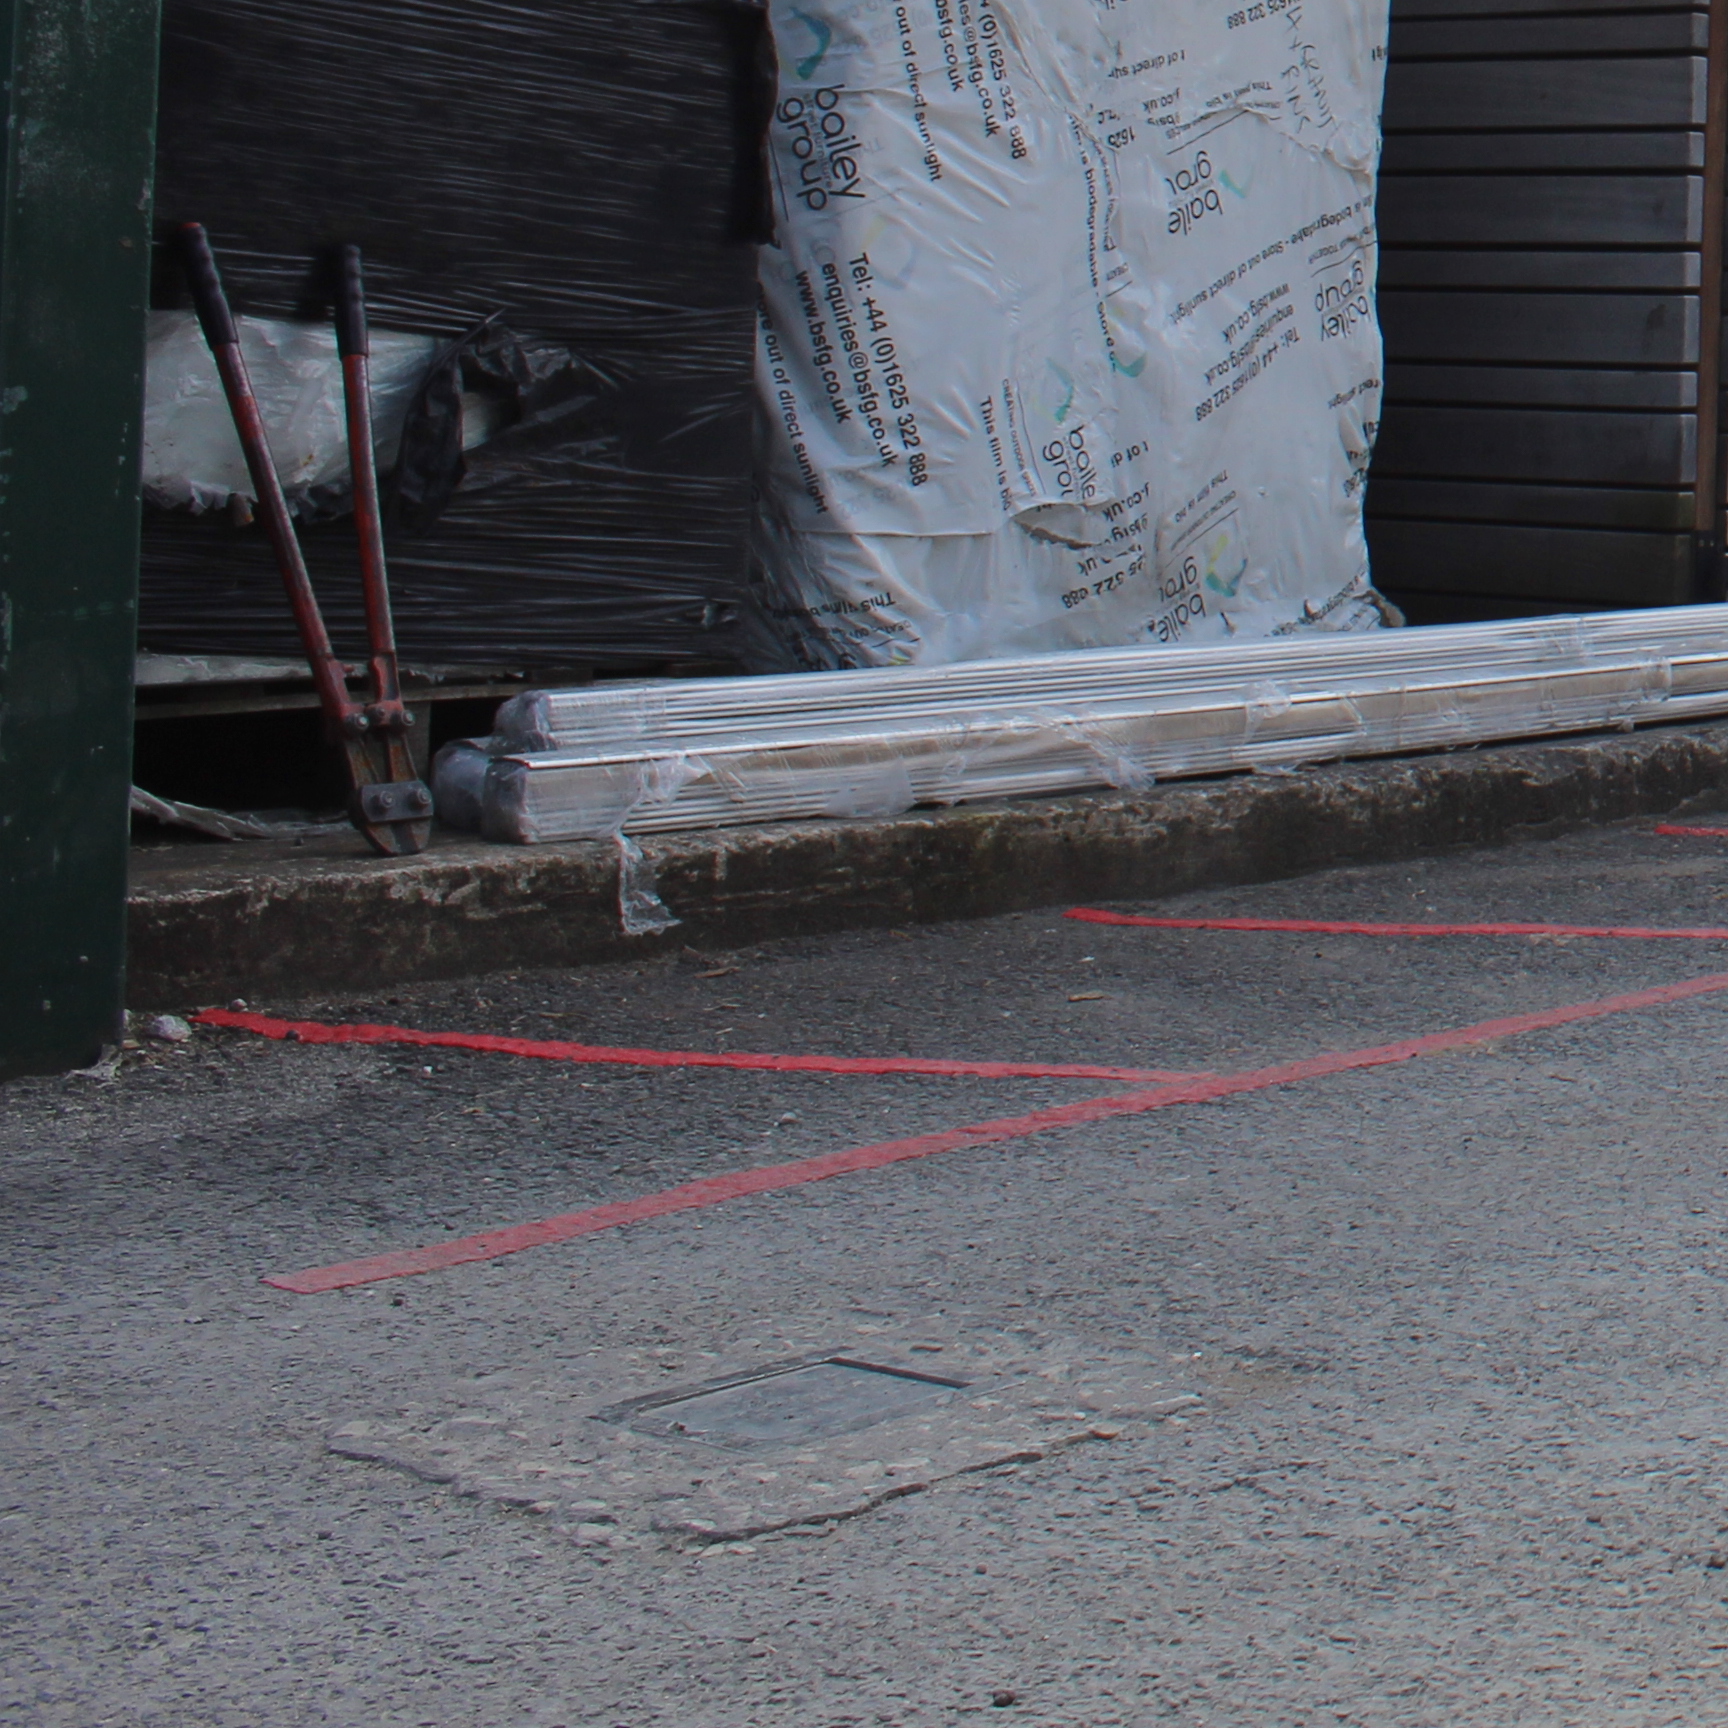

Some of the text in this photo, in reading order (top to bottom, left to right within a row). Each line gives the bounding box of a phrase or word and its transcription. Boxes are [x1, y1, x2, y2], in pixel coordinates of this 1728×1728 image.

[895, 6, 912, 36] out
[902, 40, 917, 58] of
[977, 12, 1008, 82] (0)1625
[999, 84, 1017, 122] 322
[905, 61, 929, 109] direct
[776, 97, 828, 211] group
[815, 83, 866, 199] bailey
[1209, 269, 1237, 299] direct
[764, 333, 785, 365] out
[795, 269, 855, 425] www.bsfg.co.uk
[821, 261, 900, 468] enquiries@bsfg.co.uk
[848, 252, 929, 488] Tel: +44 (0)1625 322 888
[772, 366, 792, 387] of
[777, 388, 805, 440] direct
[979, 395, 997, 436] This
[791, 442, 830, 516] sunlight
